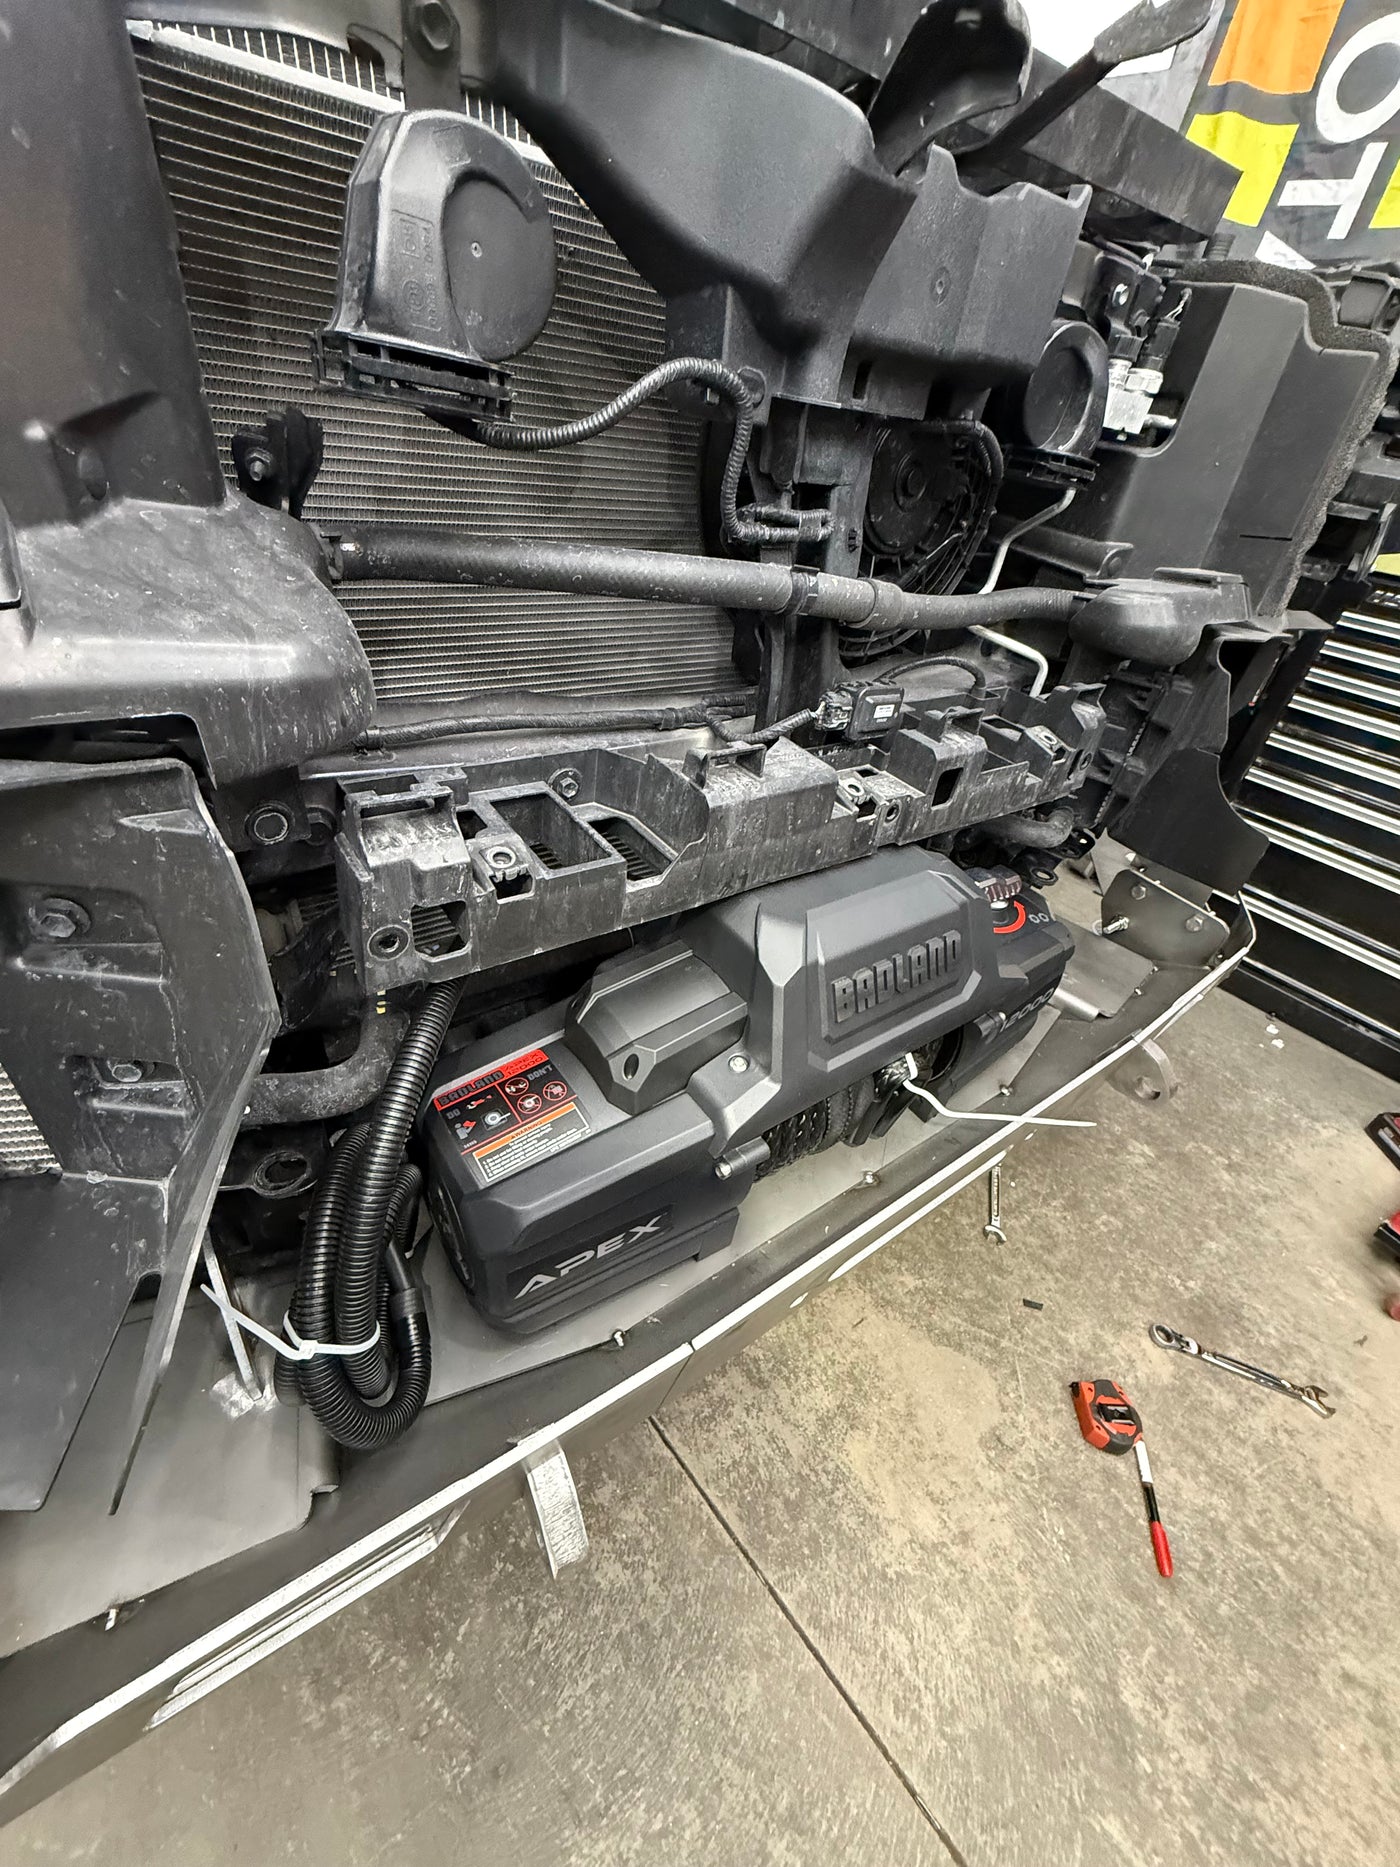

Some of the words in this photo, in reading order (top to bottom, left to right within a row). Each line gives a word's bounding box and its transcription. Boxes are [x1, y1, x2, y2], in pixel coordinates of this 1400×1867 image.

[831, 929, 961, 1023] BADLAND
[504, 1052, 539, 1071] APEX
[527, 1064, 553, 1081] DON'T
[438, 1069, 504, 1107] BADLAND
[446, 1108, 461, 1120] DO
[514, 1211, 668, 1300] APEX
